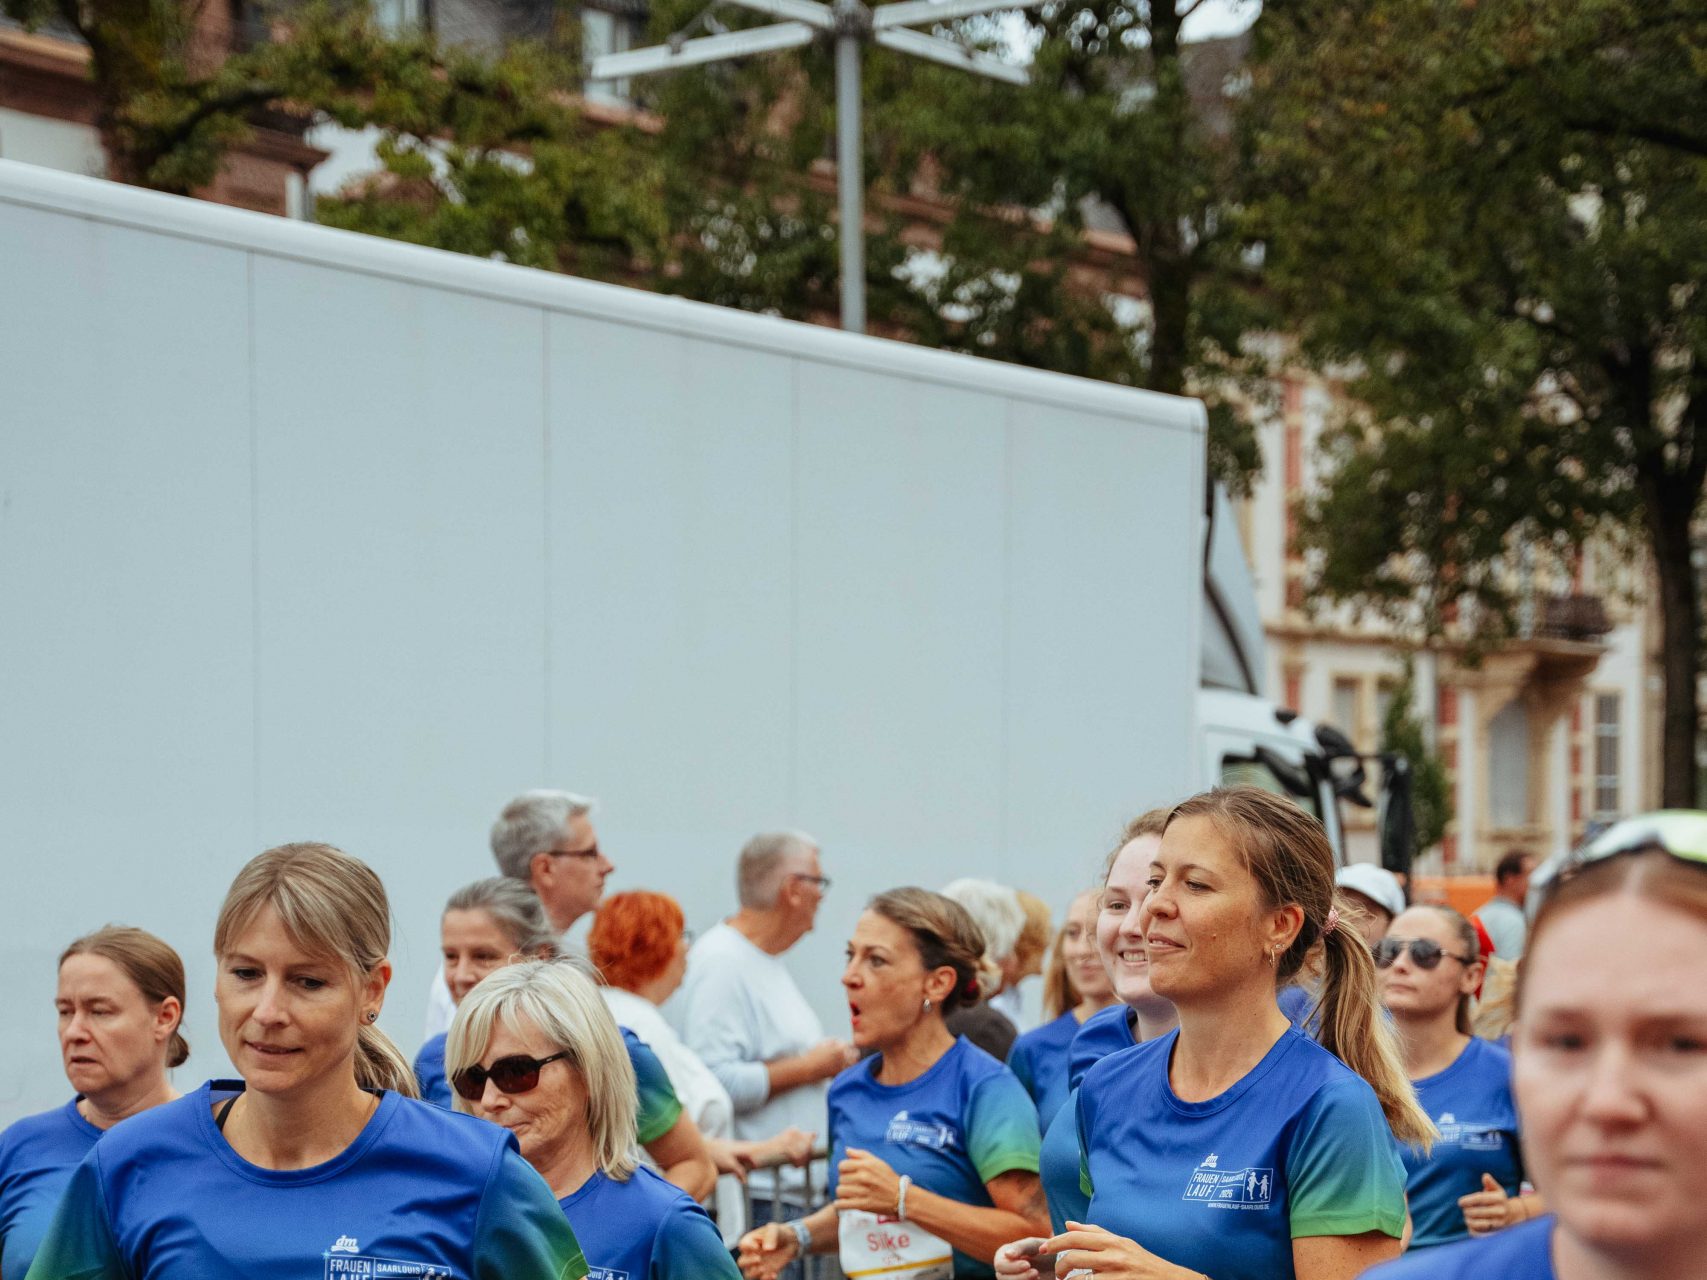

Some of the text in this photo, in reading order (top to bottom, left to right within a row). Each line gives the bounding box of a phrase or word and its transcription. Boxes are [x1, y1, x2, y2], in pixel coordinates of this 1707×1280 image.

[1193, 1173, 1219, 1184] FRAUEN
[1187, 1184, 1214, 1197] LAUF
[867, 1231, 910, 1251] Silke
[330, 1259, 370, 1274] FRAUEN
[377, 1264, 420, 1275] SAARLOUIS
